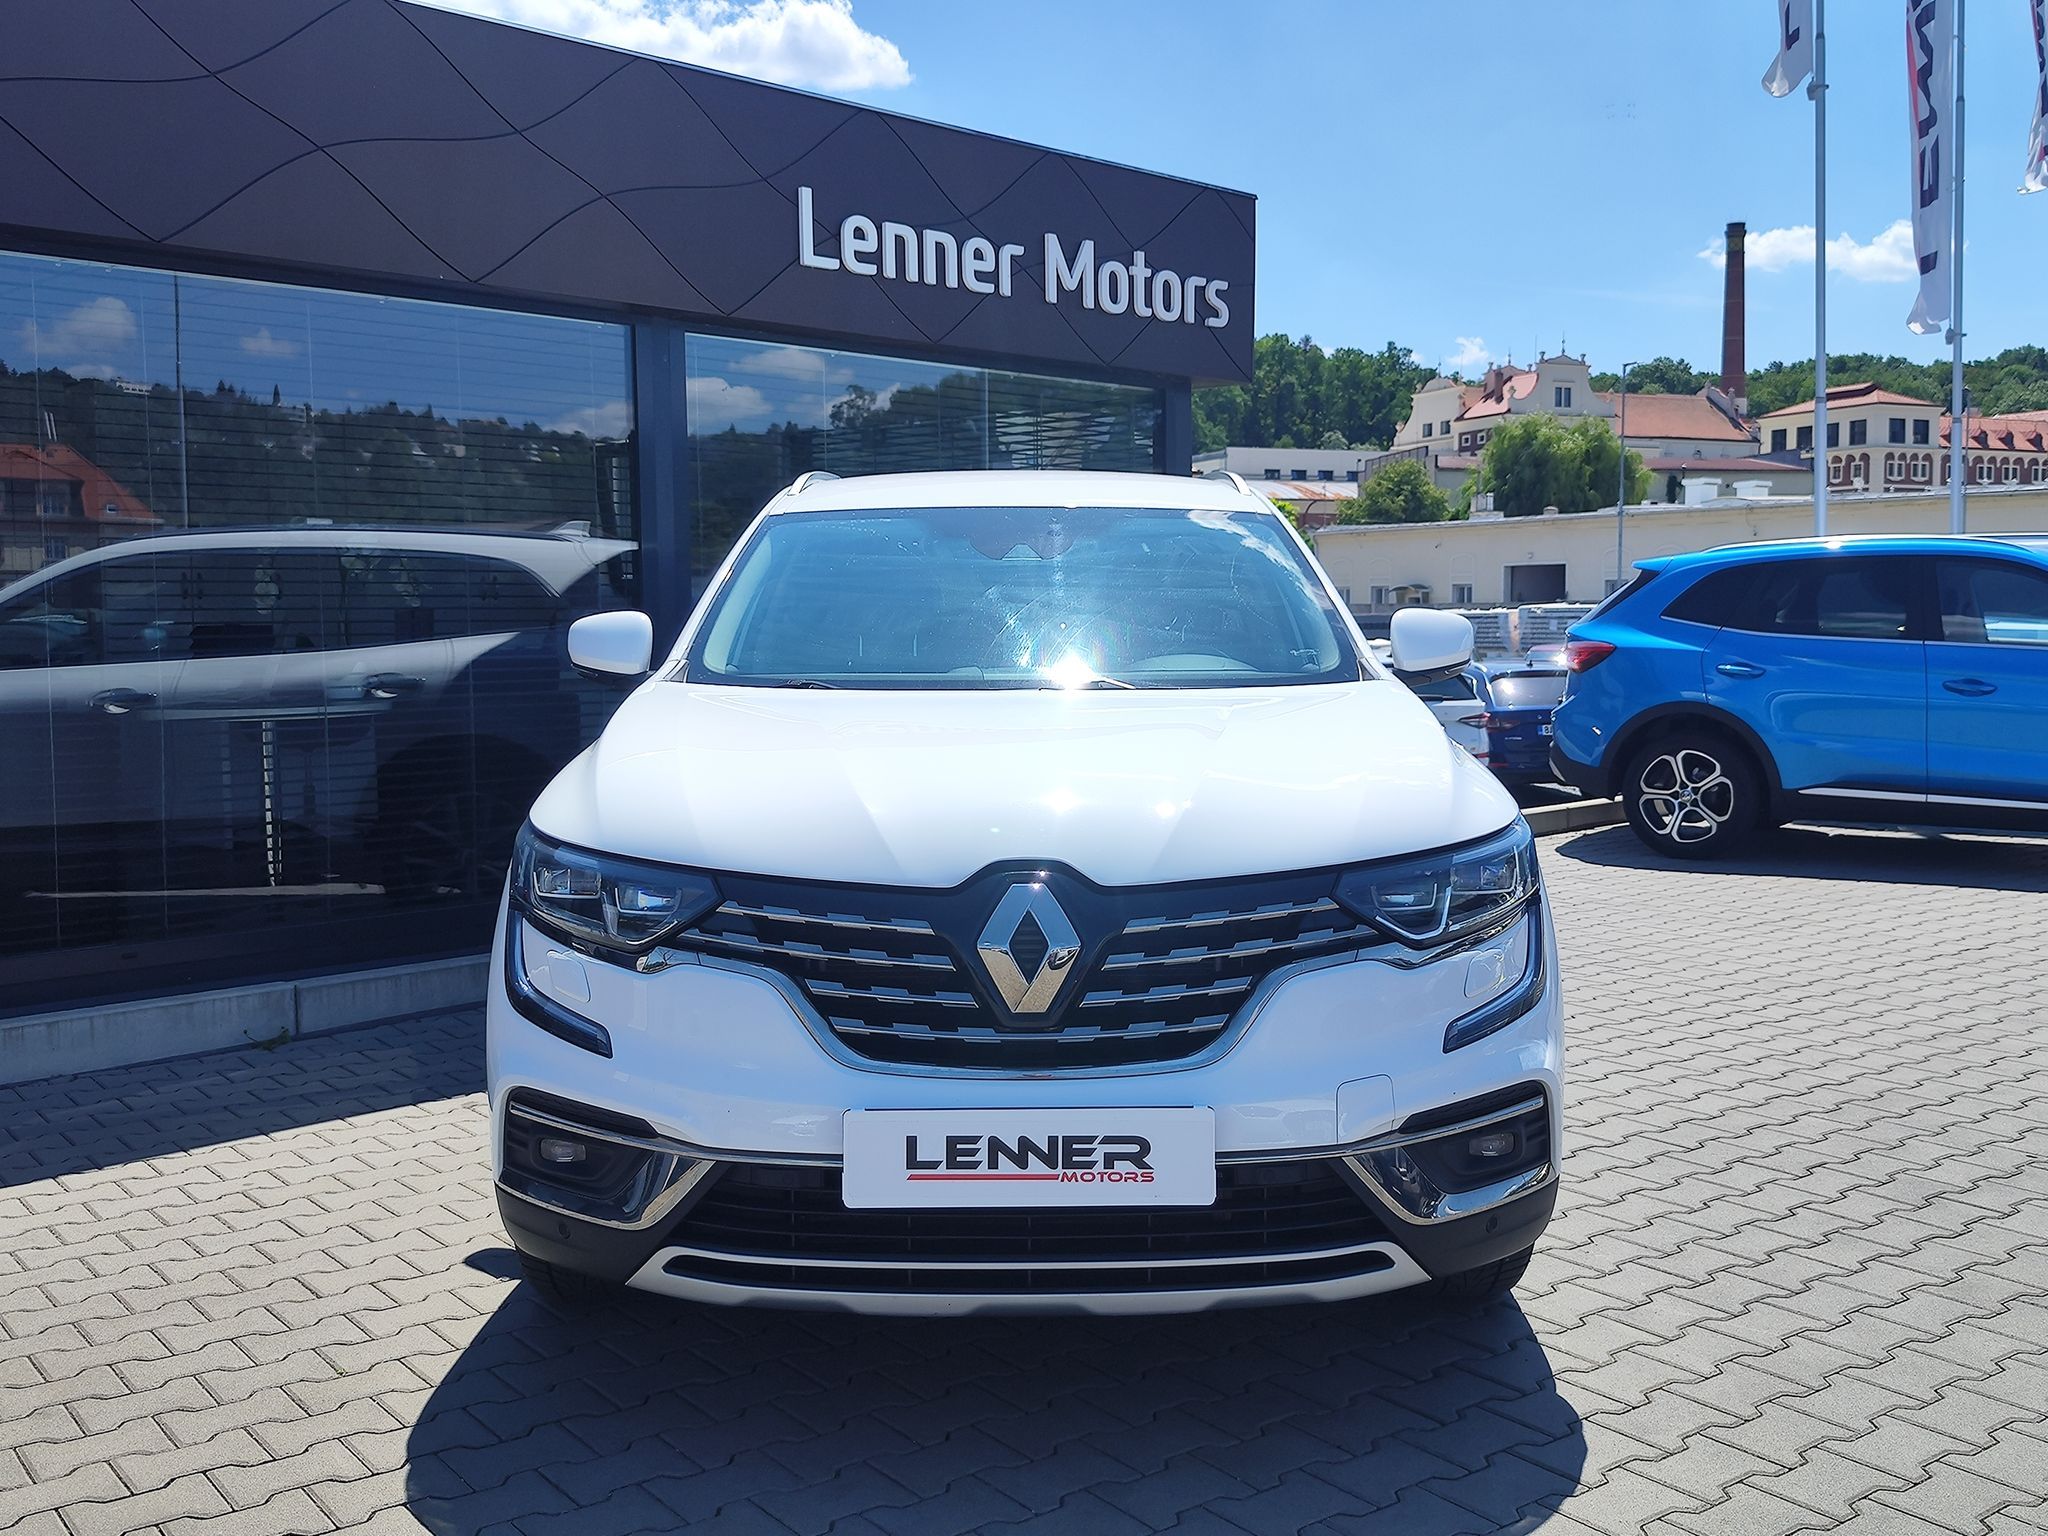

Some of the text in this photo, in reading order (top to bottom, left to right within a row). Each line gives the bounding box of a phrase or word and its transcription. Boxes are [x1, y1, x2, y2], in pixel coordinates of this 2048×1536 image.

[798, 186, 1230, 328] Lenner Motors
[905, 1135, 1155, 1170] LENNER
[1059, 1171, 1155, 1183] MOTORS
